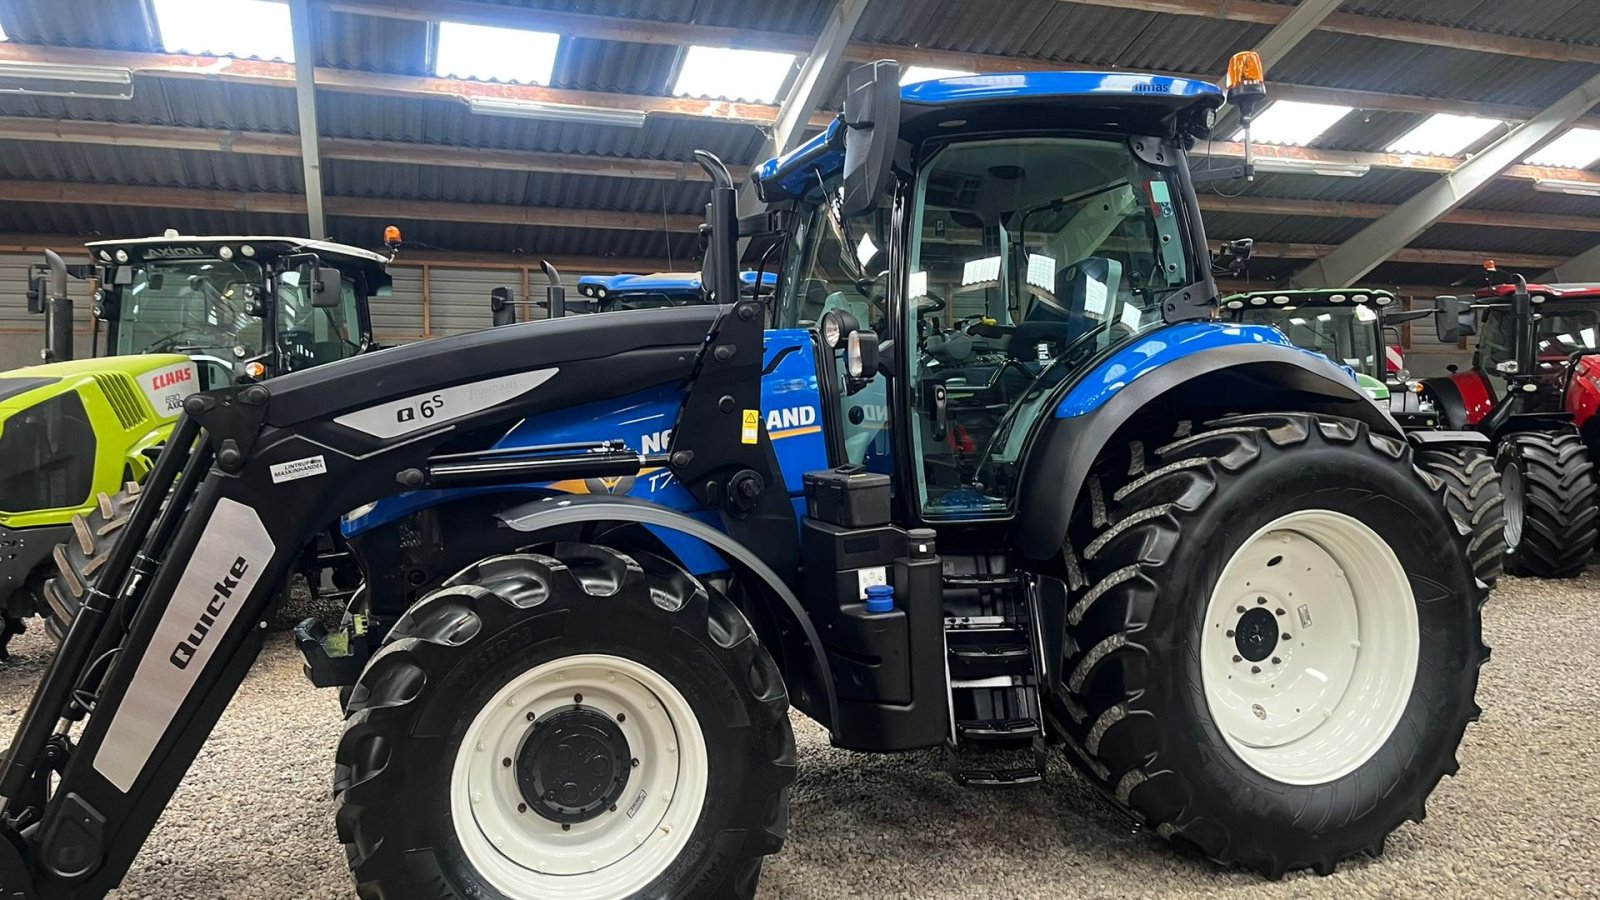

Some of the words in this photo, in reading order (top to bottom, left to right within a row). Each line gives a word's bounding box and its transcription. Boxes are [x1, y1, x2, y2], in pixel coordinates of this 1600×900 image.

[148, 245, 203, 256] AXION
[152, 367, 191, 391] CLAAS
[167, 400, 184, 410] AXIO
[766, 405, 815, 430] AND
[169, 556, 248, 670] Quicke
